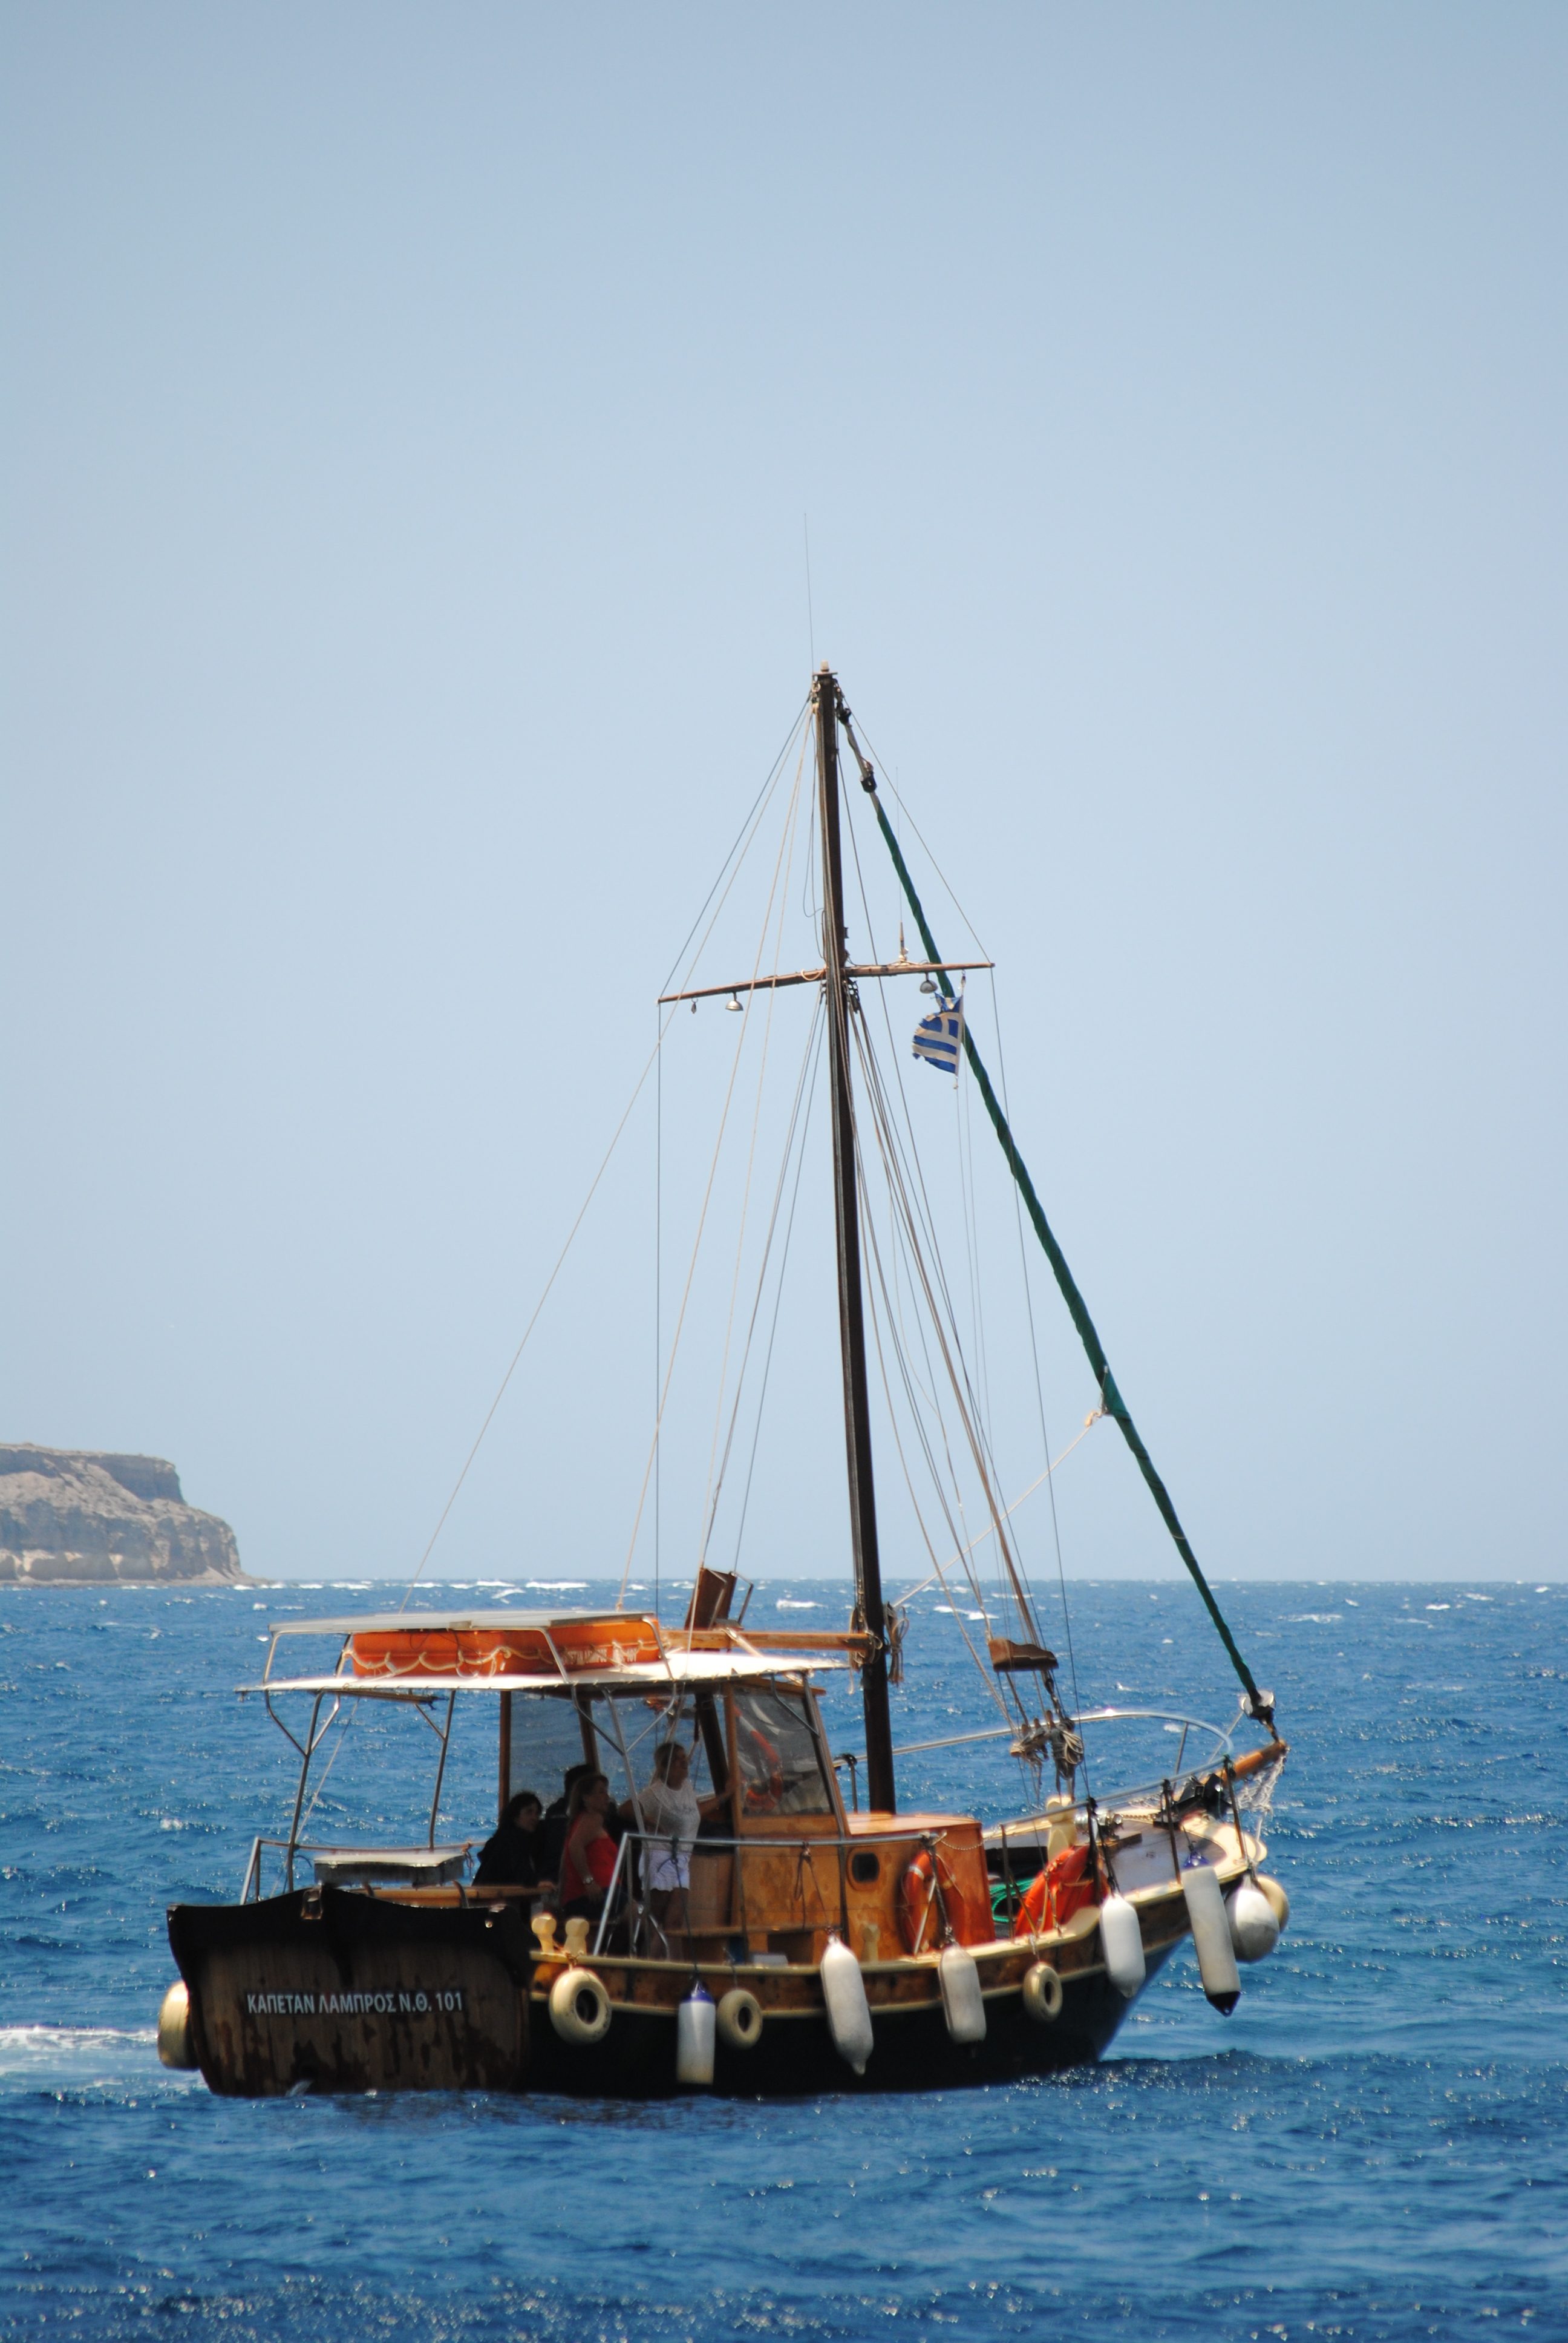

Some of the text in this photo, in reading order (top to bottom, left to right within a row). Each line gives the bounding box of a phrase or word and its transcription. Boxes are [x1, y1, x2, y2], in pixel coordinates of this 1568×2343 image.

[247, 1994, 315, 2013] ΚΑΠΕΤΑΝ
[319, 1994, 396, 2013] ΛΑΜΠΡΟΣ
[436, 1992, 462, 2011] 101
